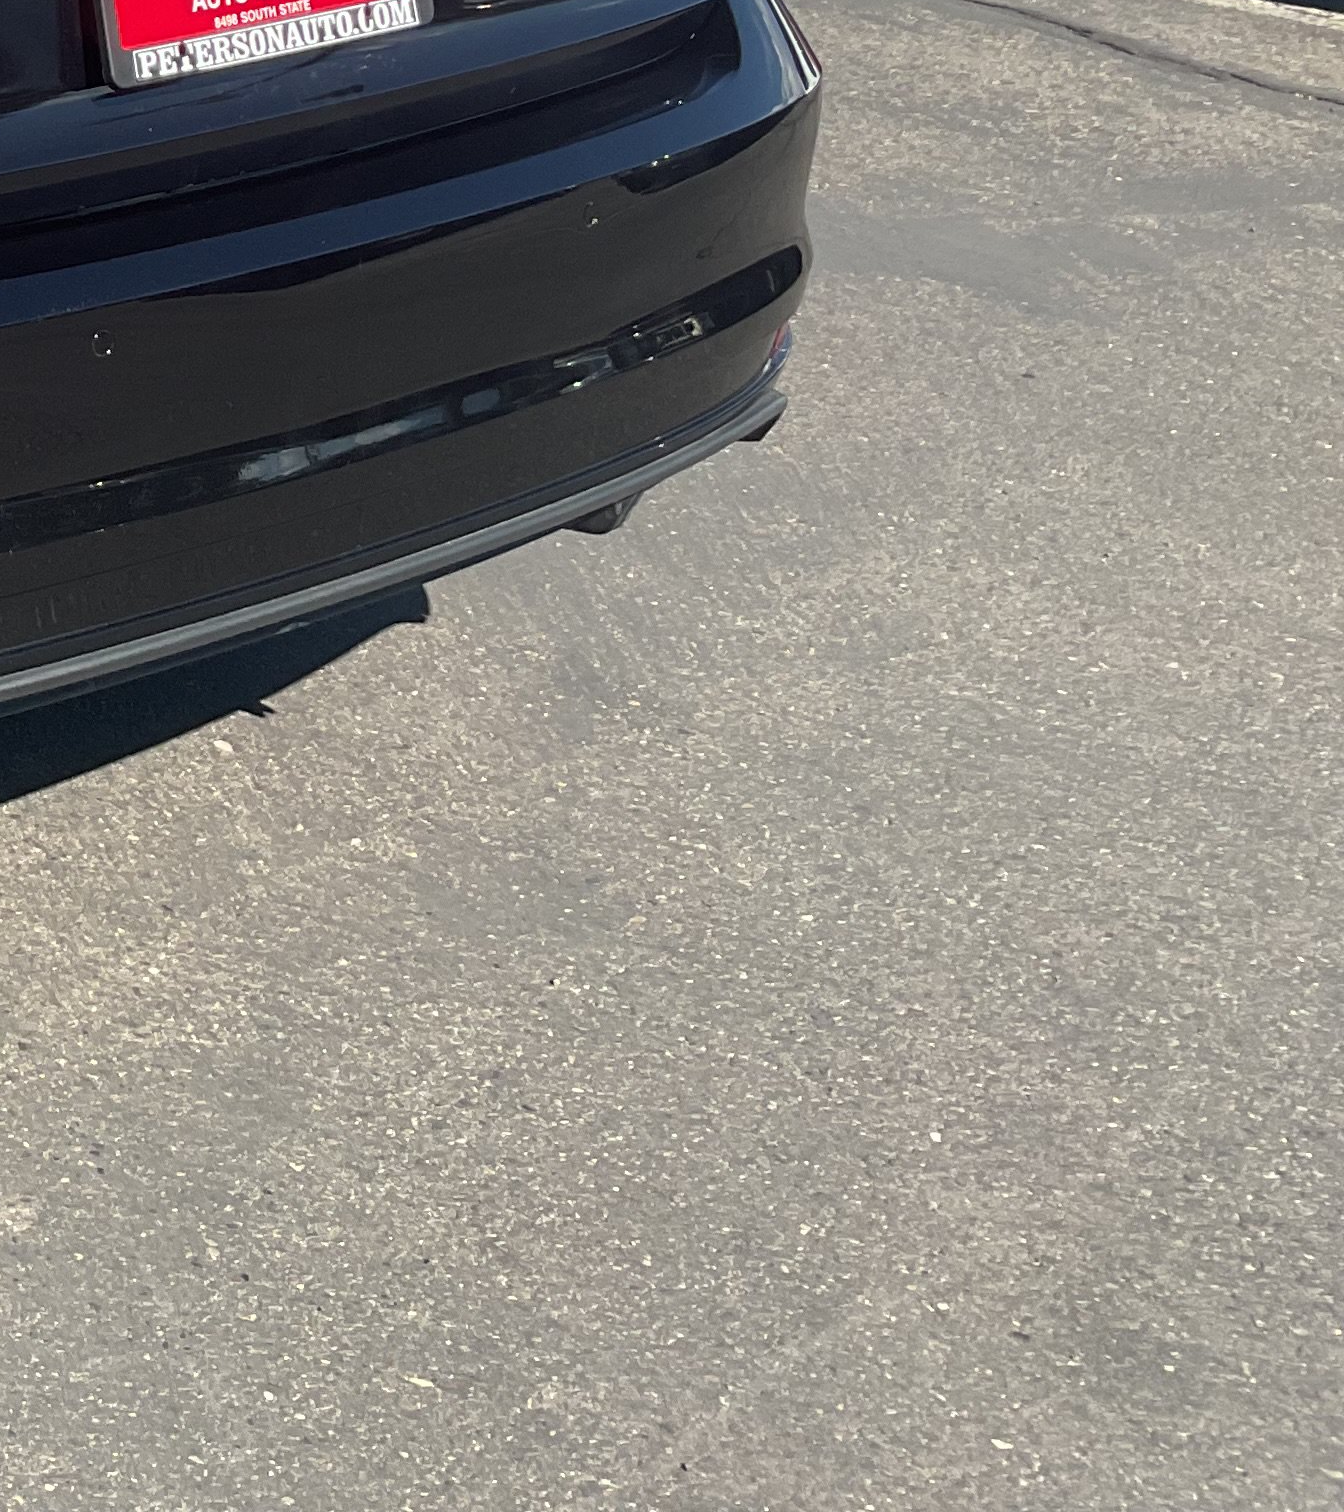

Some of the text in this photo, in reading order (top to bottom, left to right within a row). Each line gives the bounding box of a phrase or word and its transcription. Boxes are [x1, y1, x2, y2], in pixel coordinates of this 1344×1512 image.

[214, 0, 311, 29] 8498 SOUTH STATE
